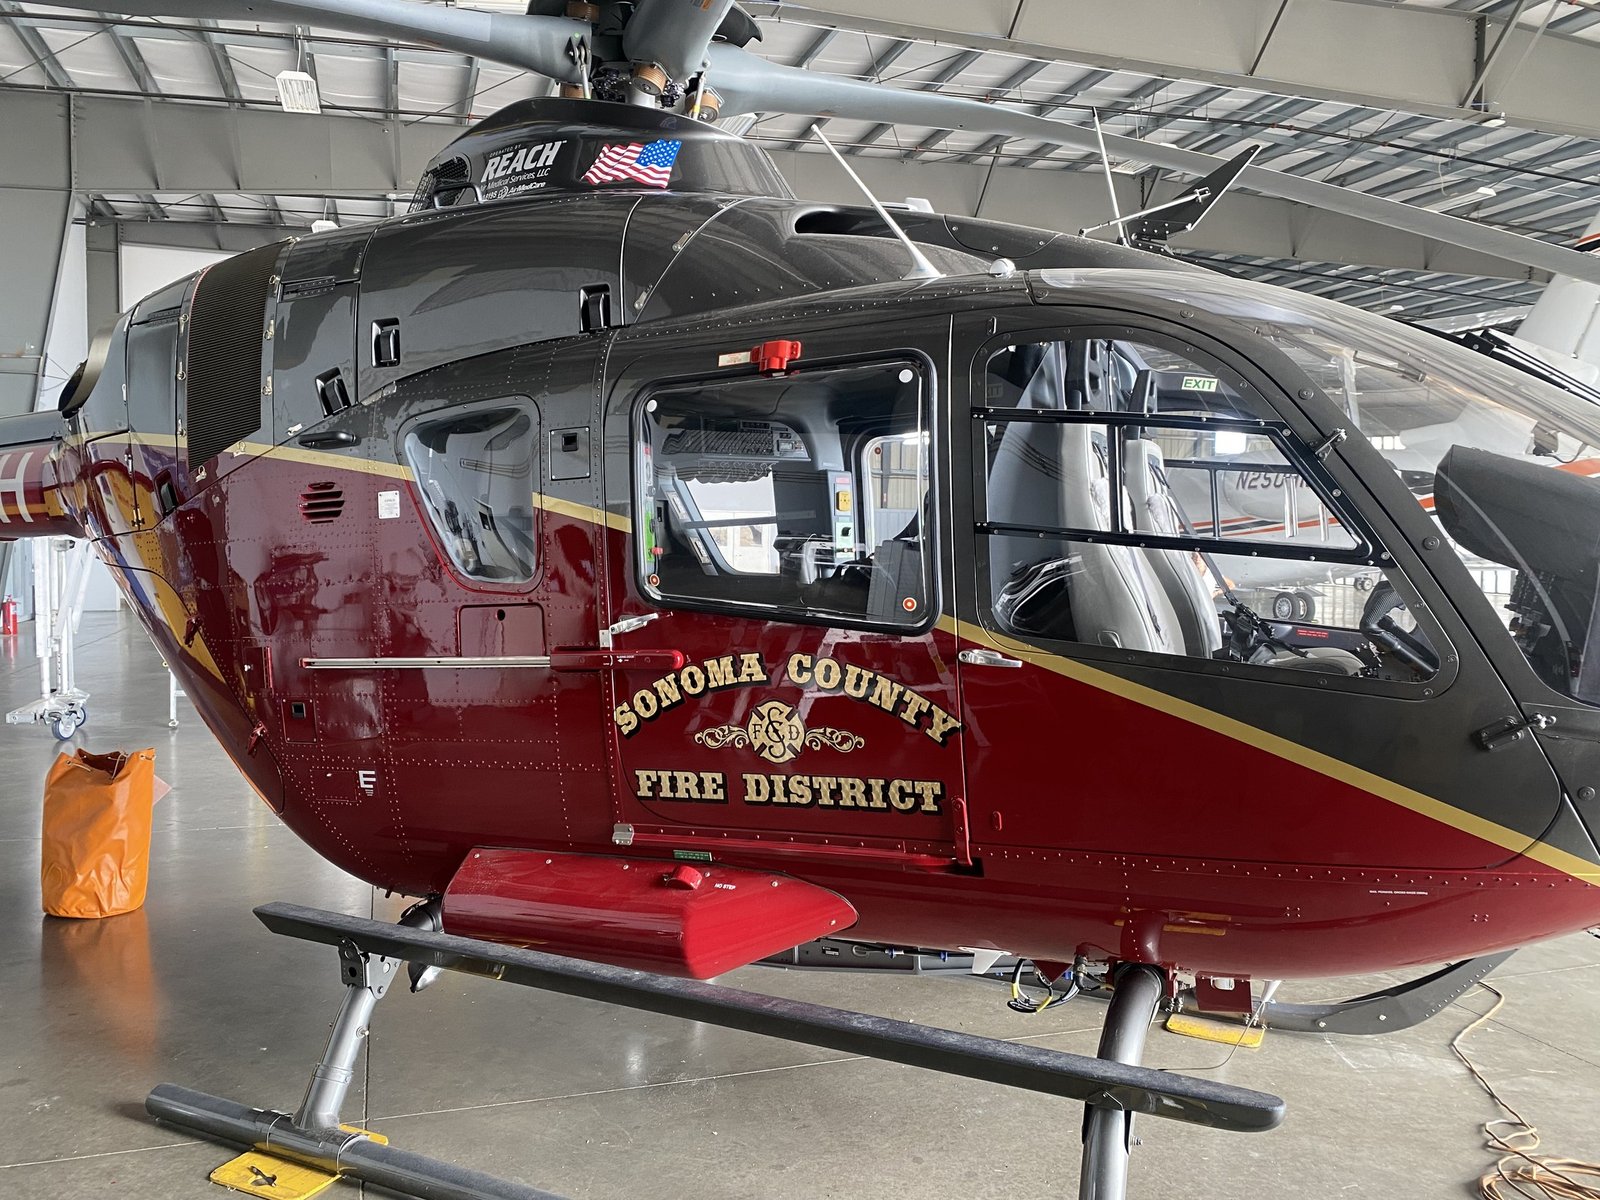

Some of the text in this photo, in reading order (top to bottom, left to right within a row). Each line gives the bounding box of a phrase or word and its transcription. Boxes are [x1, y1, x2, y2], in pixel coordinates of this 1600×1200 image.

[480, 141, 562, 183] REACH
[487, 177, 510, 189] Medical
[536, 168, 551, 178] LLC
[508, 182, 546, 194] AirMedCare
[1183, 379, 1215, 389] EXIT
[614, 653, 962, 743] SONOMA COUNTY
[635, 770, 941, 812] FIRE DISTRICT
